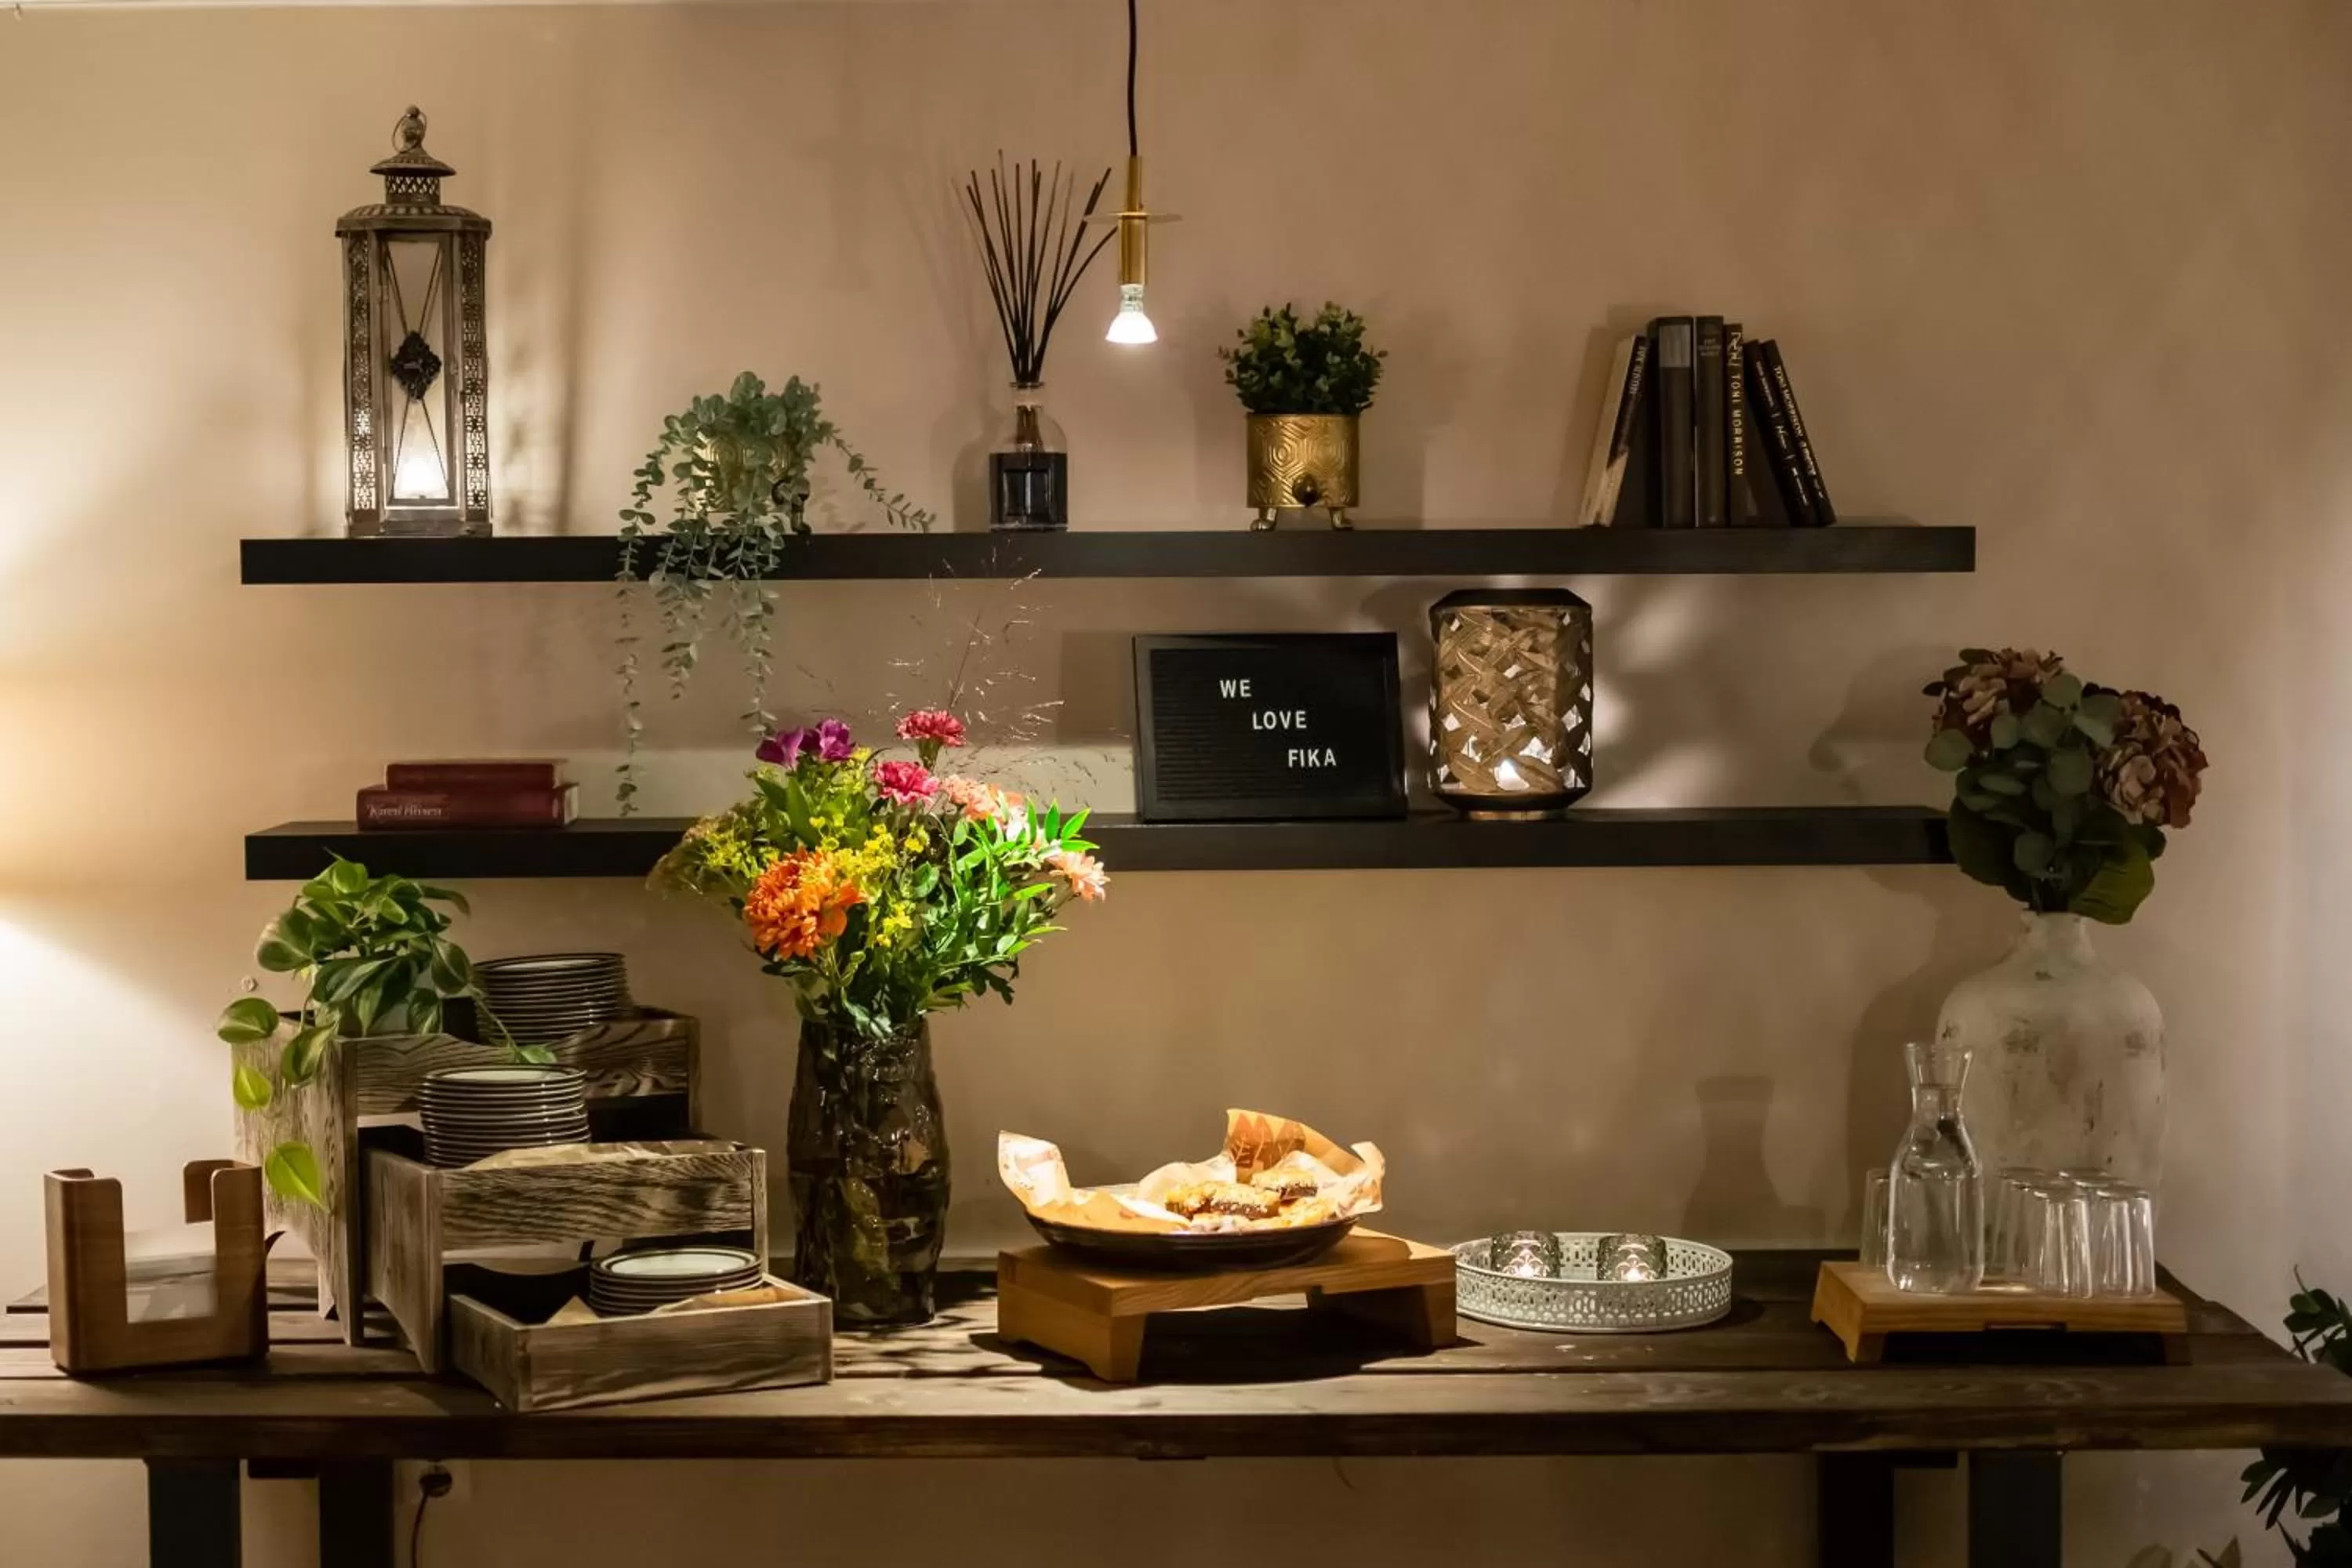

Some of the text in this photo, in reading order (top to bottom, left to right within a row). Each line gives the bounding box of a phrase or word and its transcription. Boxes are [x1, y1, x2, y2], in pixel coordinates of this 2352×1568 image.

[1730, 374, 1742, 403] TONI
[1731, 409, 1744, 475] MORRISON
[1219, 679, 1252, 699] WE
[1252, 710, 1307, 730] LOVE
[1287, 748, 1337, 768] FIKA
